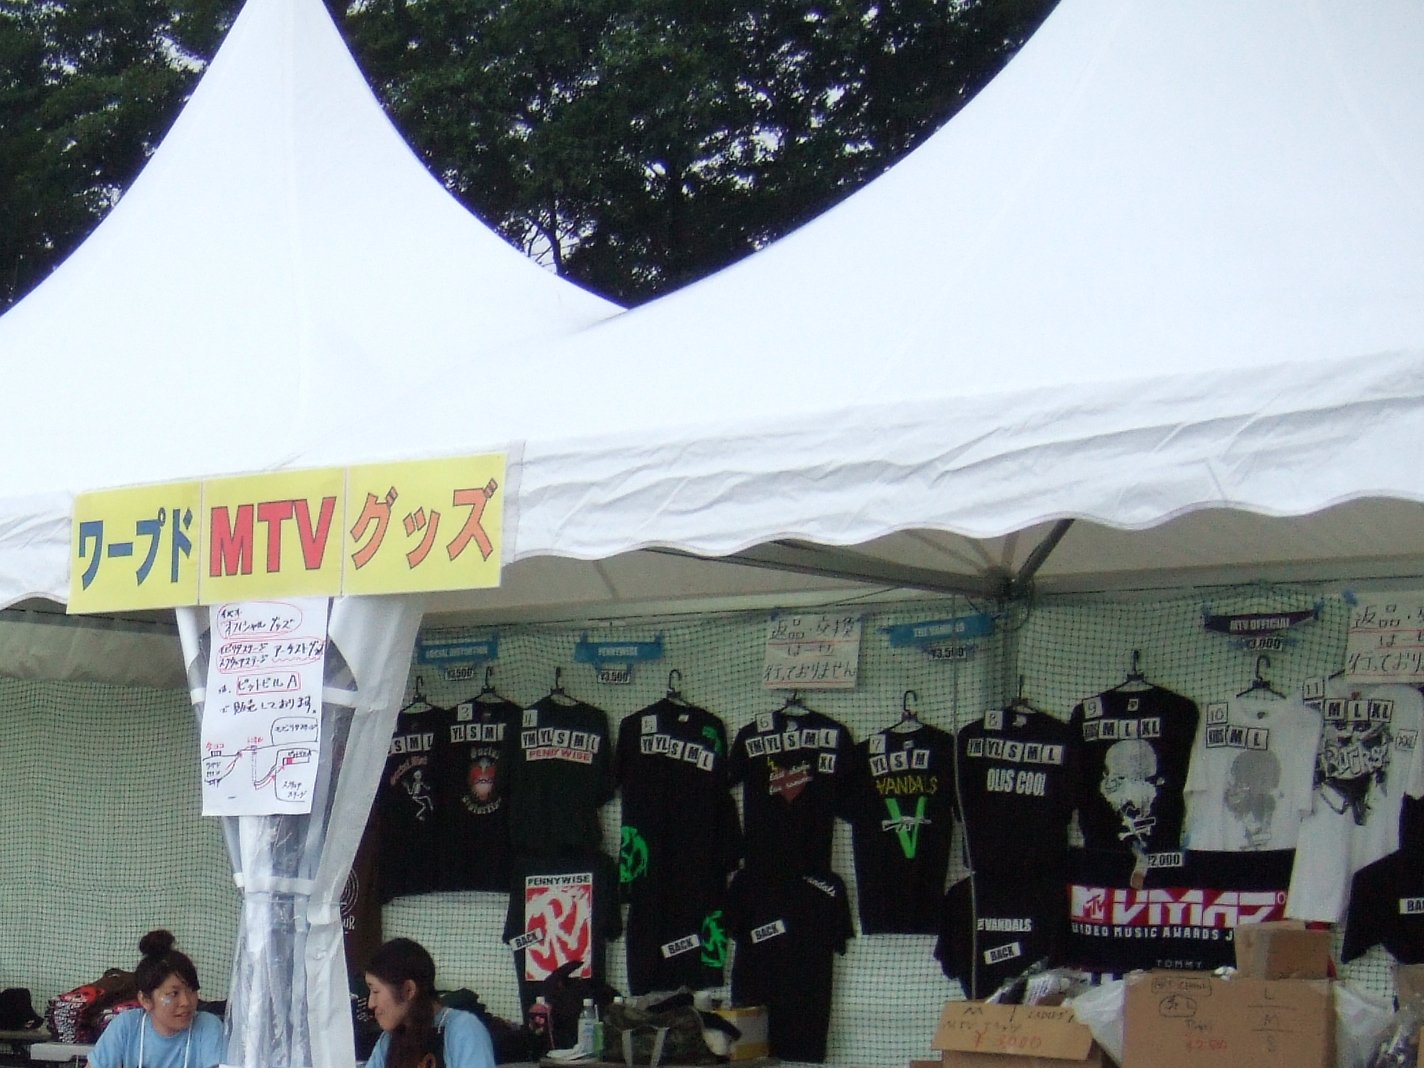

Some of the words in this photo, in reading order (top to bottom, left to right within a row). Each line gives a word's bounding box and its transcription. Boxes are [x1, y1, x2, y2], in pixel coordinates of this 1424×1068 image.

[78, 507, 192, 591] ワープド
[209, 496, 336, 577] MTV
[350, 477, 499, 570] グッズ
[287, 675, 298, 689] A
[1328, 702, 1340, 717] M
[1371, 702, 1389, 719] XL
[452, 726, 463, 740] YL
[469, 725, 477, 738] S
[484, 726, 493, 739] M
[1102, 721, 1114, 736] M
[1141, 720, 1159, 735] XL
[394, 740, 401, 752] S
[409, 736, 418, 749] M
[556, 733, 564, 745] S
[573, 735, 584, 748] M
[748, 739, 764, 753] YM
[767, 736, 780, 751] YL
[788, 734, 796, 748] S
[804, 732, 816, 745] M
[1230, 729, 1242, 744] M
[656, 737, 668, 750] YL
[671, 742, 679, 755] S
[688, 746, 699, 760] M
[988, 741, 1001, 757] YL
[1008, 743, 1016, 757] S
[1027, 746, 1039, 760] M
[873, 758, 887, 774] YL
[894, 755, 902, 768] S
[915, 751, 927, 766] M
[875, 775, 938, 796] VANDALS
[528, 874, 590, 887] PENNYWISE
[755, 924, 778, 940] BACK
[985, 918, 1032, 932] VANDALS
[1071, 922, 1108, 937] VIDEO
[1114, 926, 1158, 939] MUSIC
[1162, 928, 1220, 941] AWARDS
[515, 933, 538, 949] BACK
[668, 940, 693, 954] BACK
[990, 946, 1013, 961] BACK
